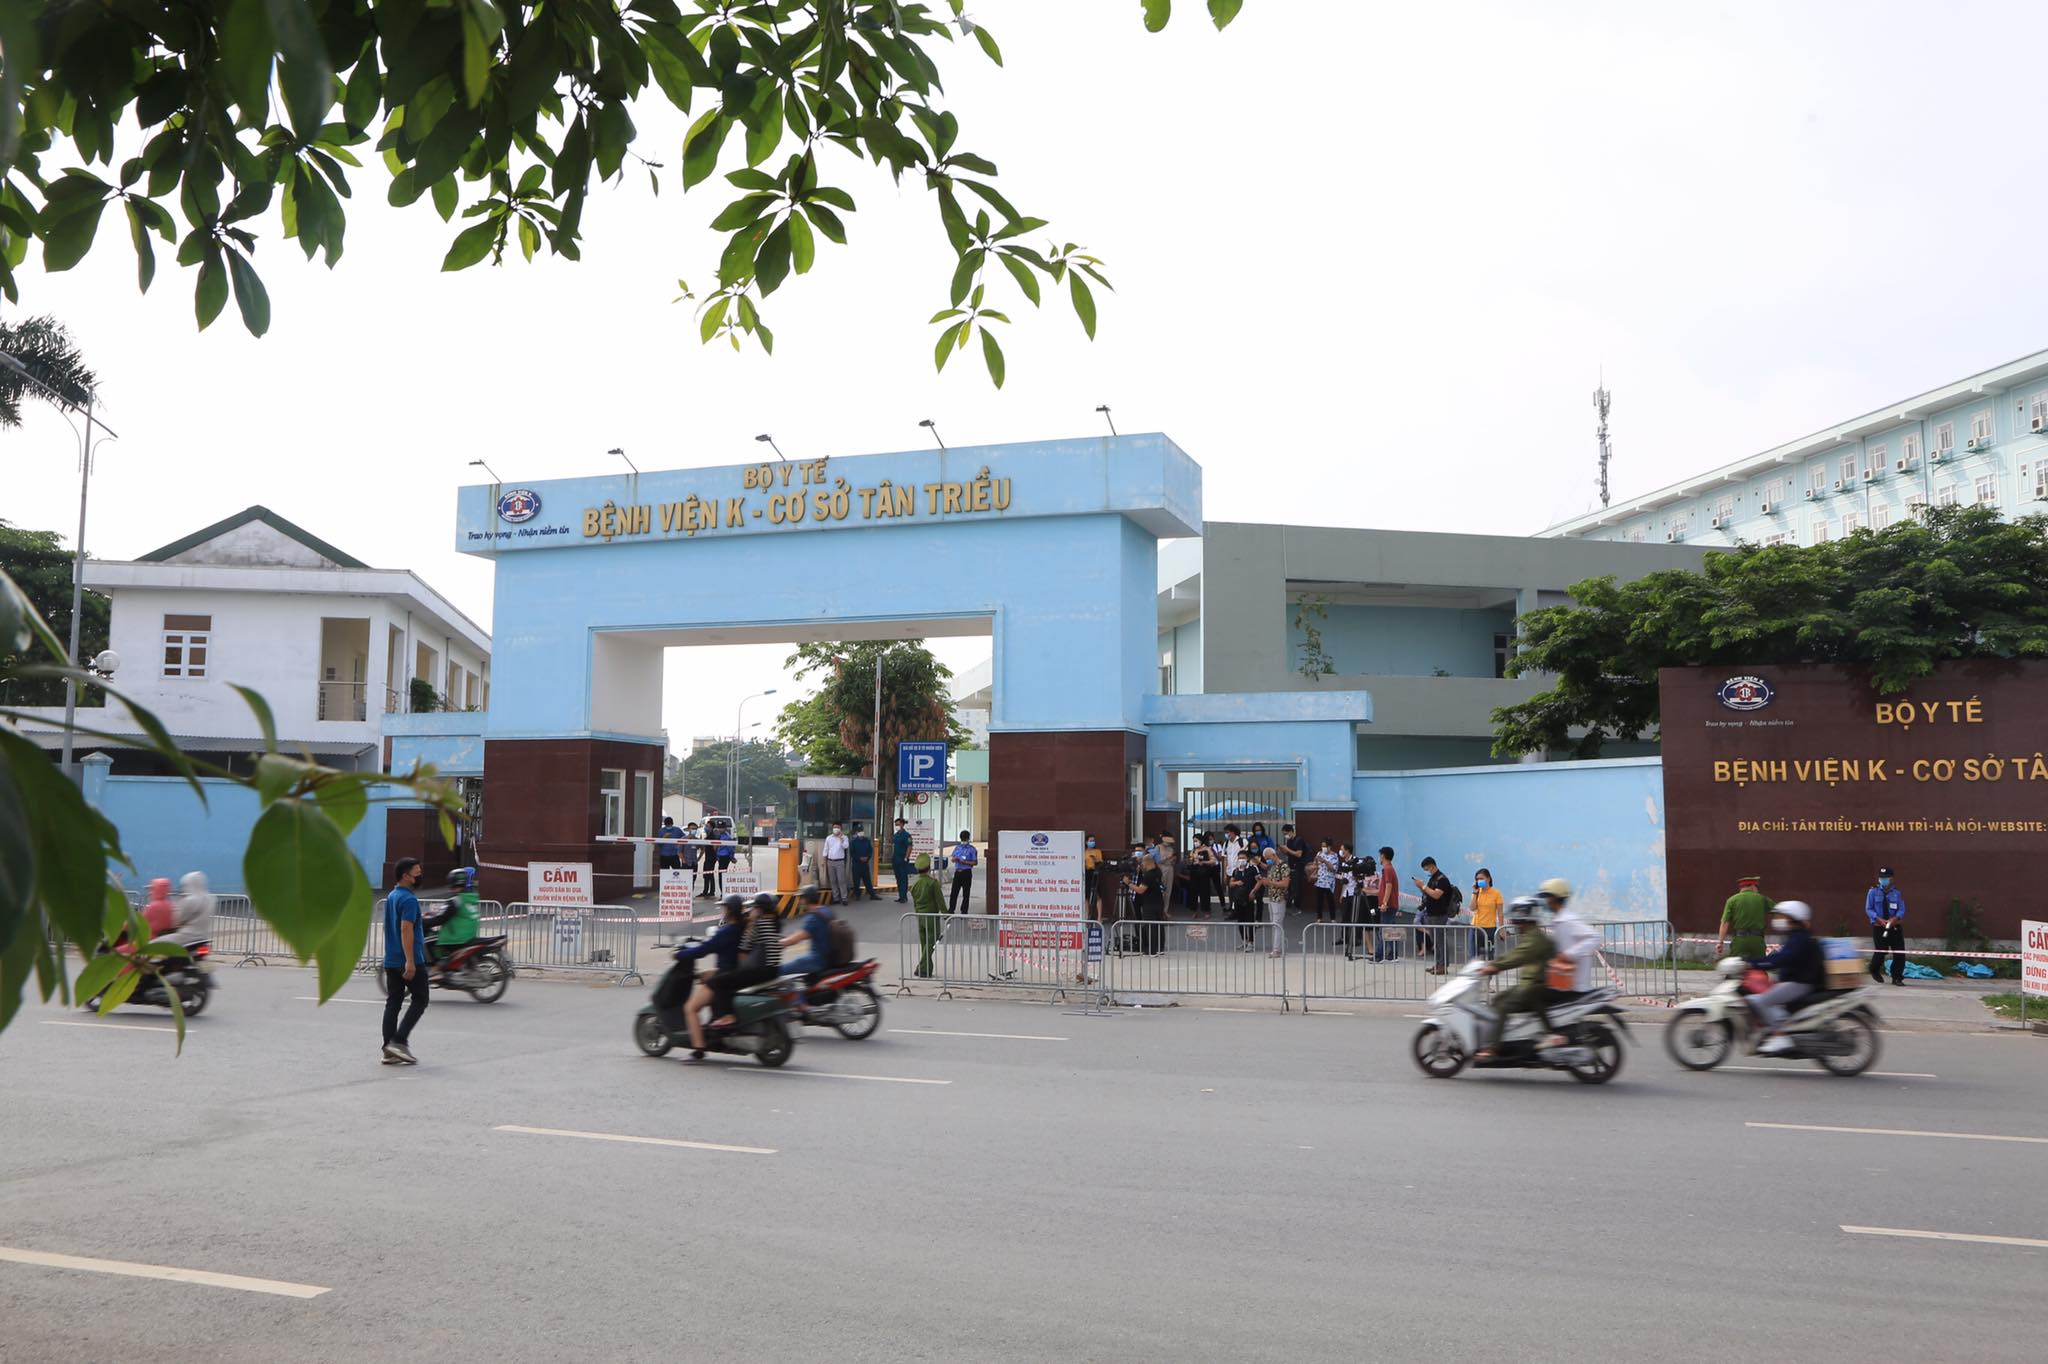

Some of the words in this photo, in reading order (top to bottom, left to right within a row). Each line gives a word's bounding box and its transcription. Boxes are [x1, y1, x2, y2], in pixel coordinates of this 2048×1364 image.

[743, 463, 773, 493] BỘ
[781, 464, 794, 486] Y
[800, 455, 830, 484] TẾ
[583, 500, 651, 542] BỆNH
[658, 494, 717, 532] VIỆN
[726, 497, 745, 527] K
[768, 488, 807, 523] CƠ
[813, 477, 852, 521] SỞ
[859, 480, 915, 518] TÂN
[924, 465, 1011, 515] TRIỀU
[1876, 699, 1915, 730] BỘ
[1922, 702, 1940, 723] Y
[1946, 695, 1983, 723] TẾ
[914, 755, 934, 776] P
[1714, 757, 1787, 787] BỆNH
[1794, 757, 1860, 787] VIỆN
[1868, 760, 1887, 781] K
[1912, 759, 1956, 781] CƠ
[1963, 753, 2005, 781] SỞ
[1738, 822, 1760, 834] ĐỊA
[1762, 818, 1789, 831] CHỈ:
[1791, 818, 1817, 831] TÂN
[1819, 816, 1851, 831] TRIỀU
[1861, 822, 1904, 831] THANH
[543, 866, 577, 882] CẤM
